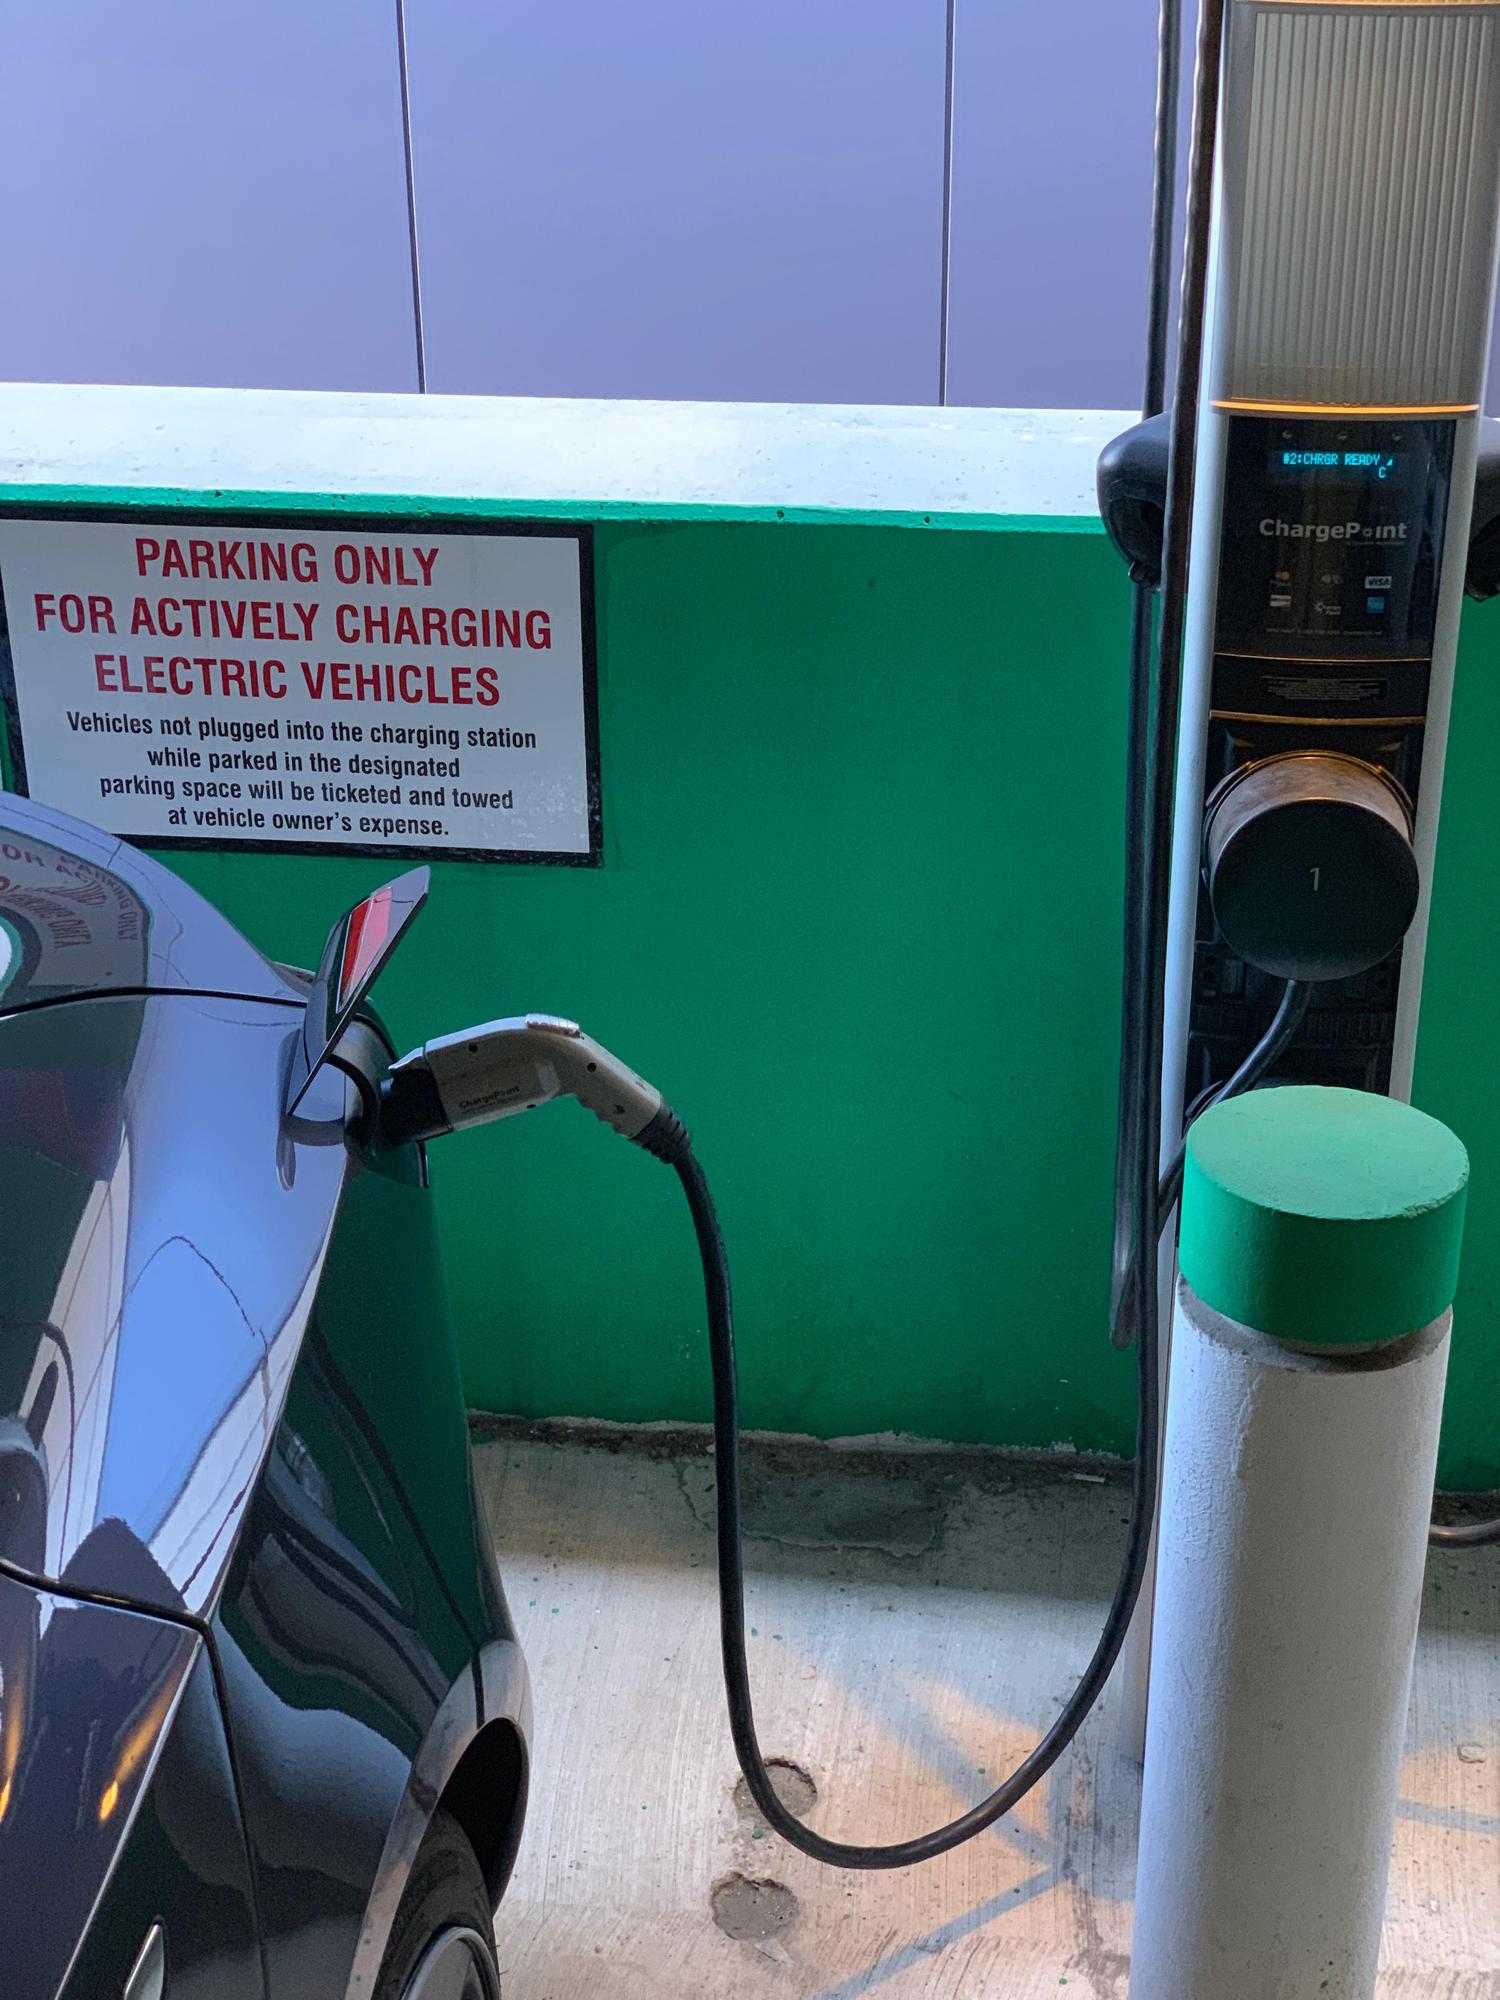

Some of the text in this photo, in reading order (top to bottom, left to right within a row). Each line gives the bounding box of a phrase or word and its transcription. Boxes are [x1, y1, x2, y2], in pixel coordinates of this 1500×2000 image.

[1344, 453, 1381, 466] READY
[1259, 518, 1408, 543] ChargePoint
[135, 538, 440, 586] PARKING ONLY
[34, 593, 552, 650] FOR ACTIVELY CHARGING
[94, 654, 500, 707] ELECTRIC VEHICLES
[66, 711, 537, 750] Vehicles not plugged into the charging station
[147, 746, 460, 780] while parked in the designated
[99, 774, 514, 810] parking space will be ticketed and towed
[168, 806, 188, 826] at
[193, 807, 265, 829] vehicle
[359, 816, 449, 838] expense.
[1310, 867, 1320, 891] 1
